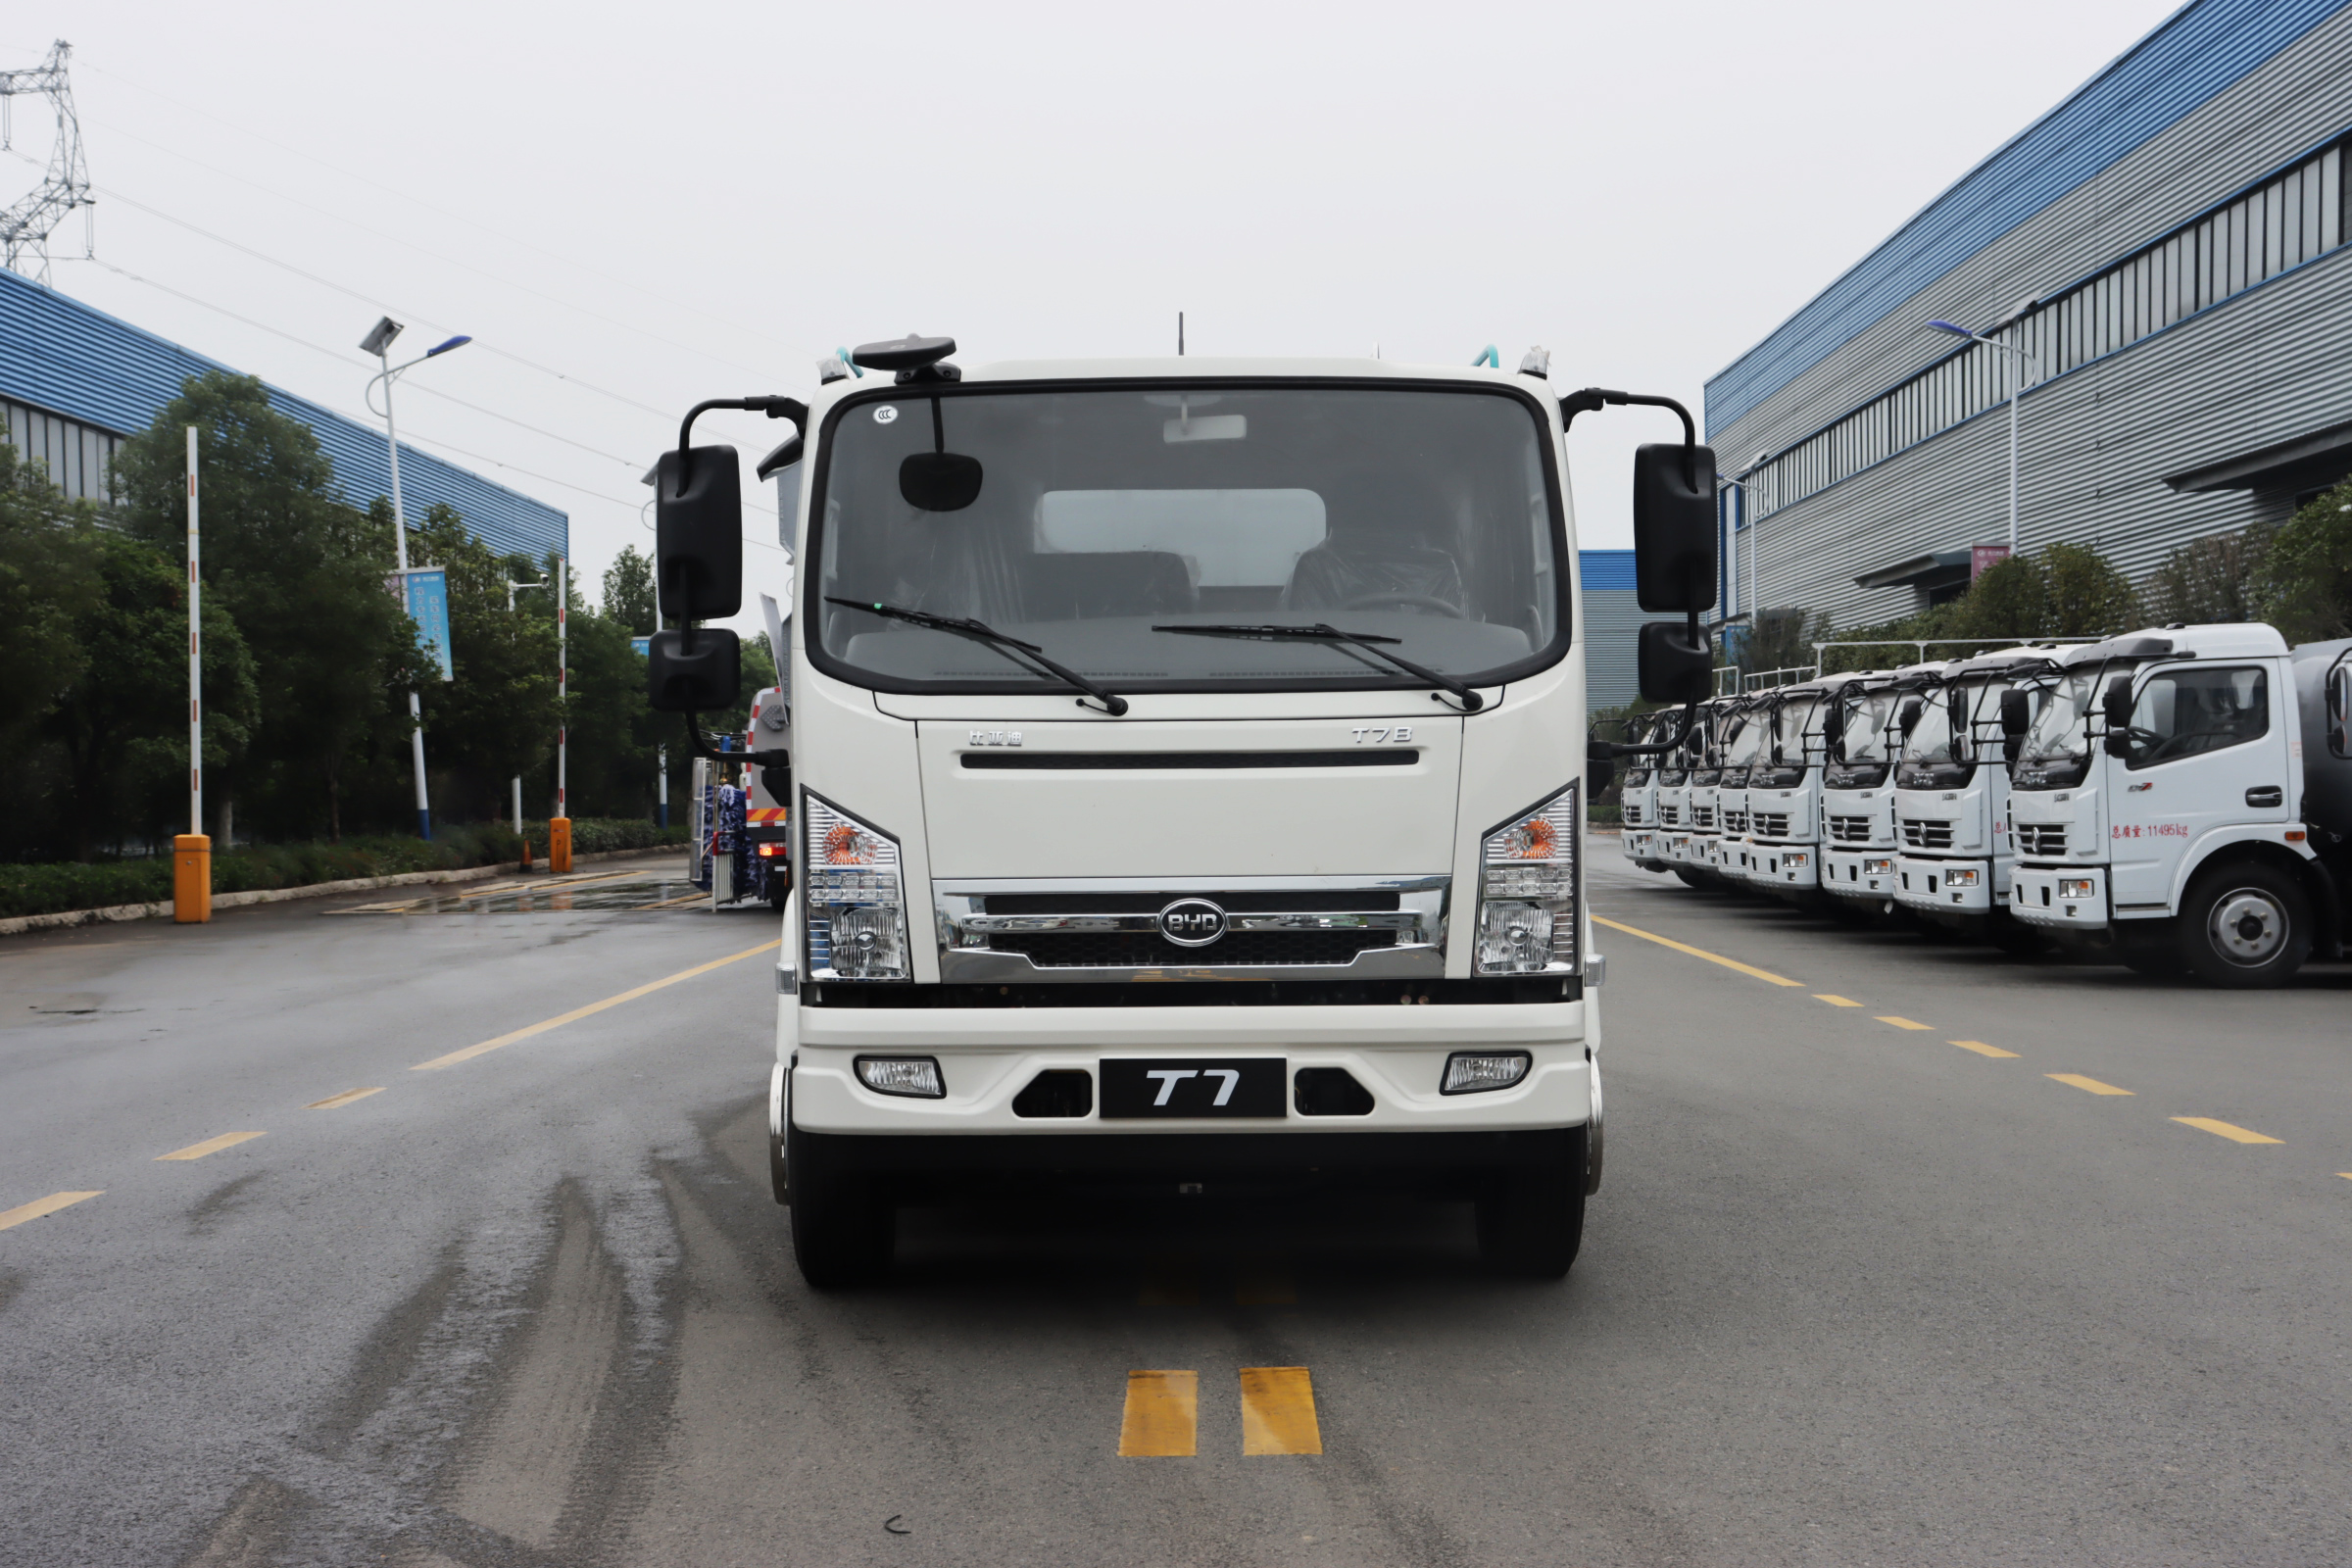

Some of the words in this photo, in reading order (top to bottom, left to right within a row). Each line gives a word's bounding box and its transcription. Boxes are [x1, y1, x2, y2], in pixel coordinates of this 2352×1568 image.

[969, 730, 1023, 746] 比亚迪
[1168, 913, 1218, 932] BYD
[1147, 1069, 1240, 1106] T7
